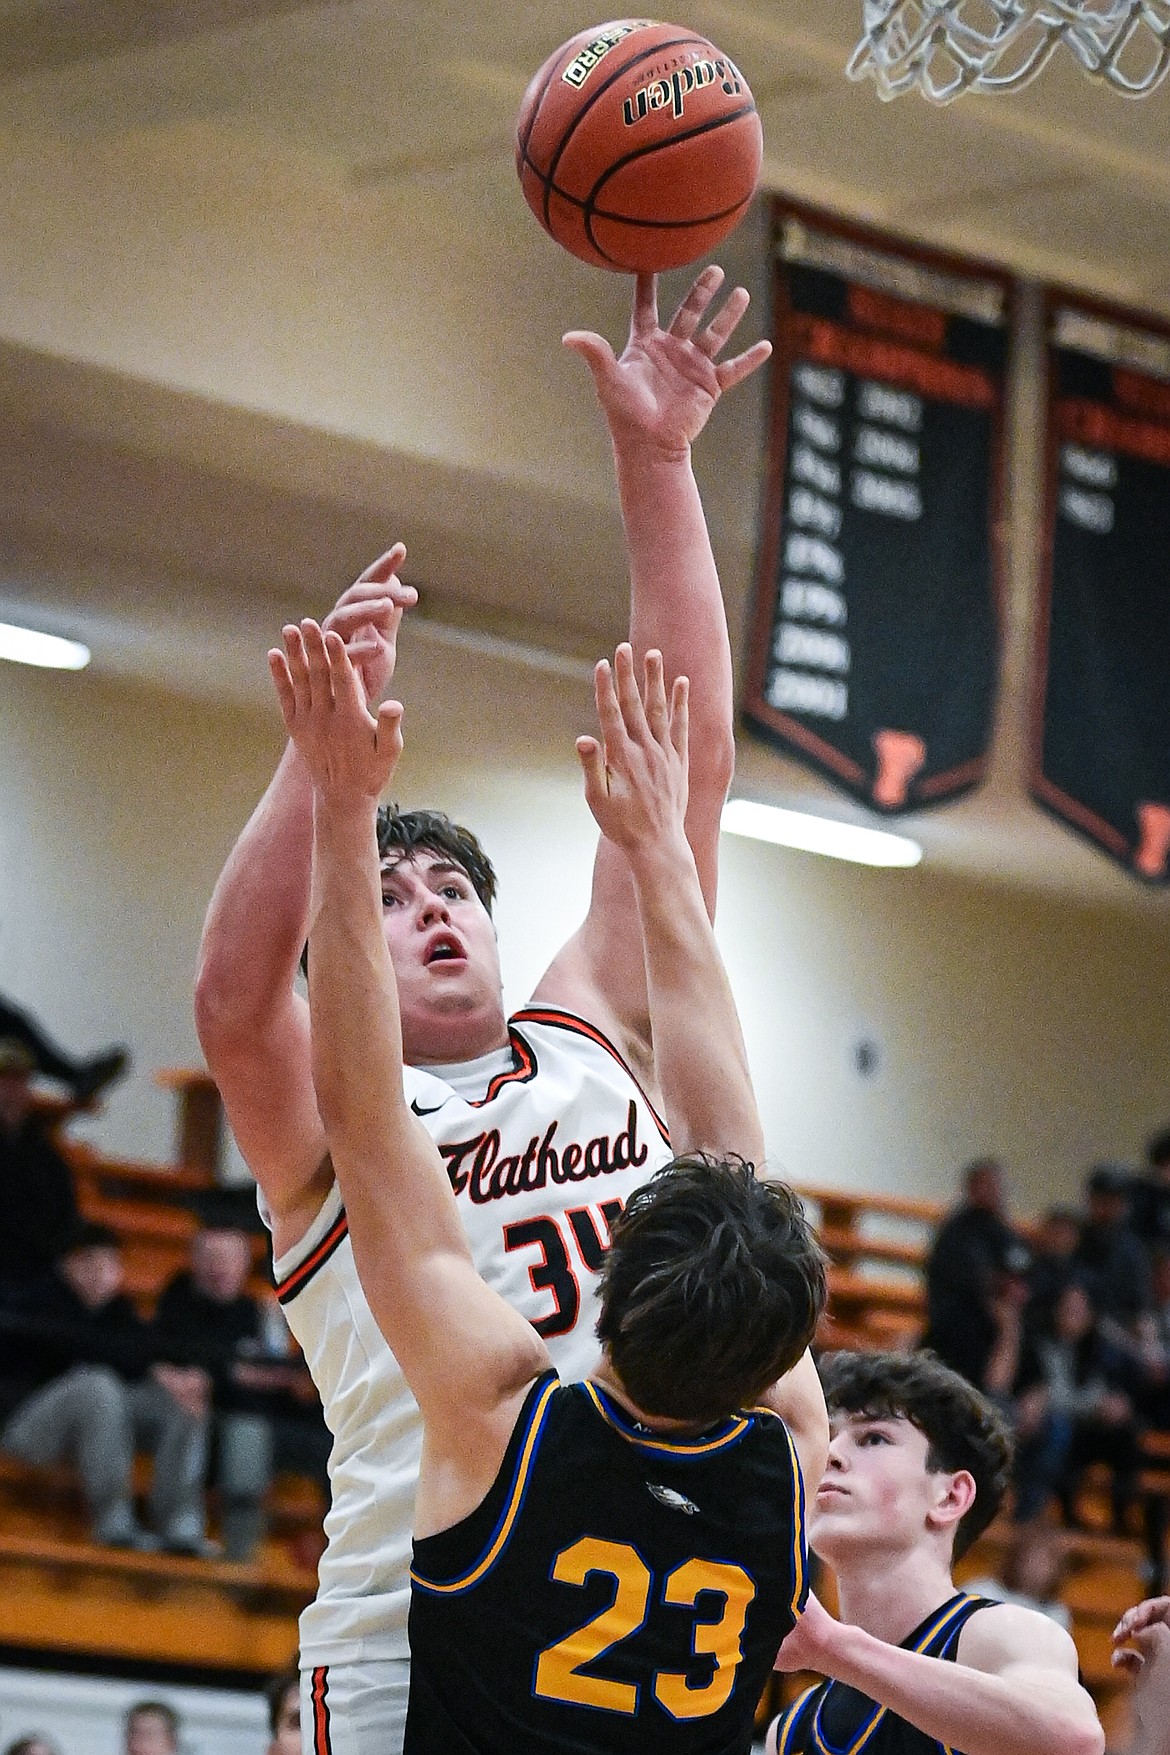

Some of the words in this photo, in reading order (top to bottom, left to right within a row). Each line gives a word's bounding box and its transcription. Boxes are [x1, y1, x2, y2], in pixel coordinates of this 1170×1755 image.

[622, 58, 742, 127] Baden
[438, 1099, 648, 1204] Flathead
[532, 1534, 756, 1721] 23
